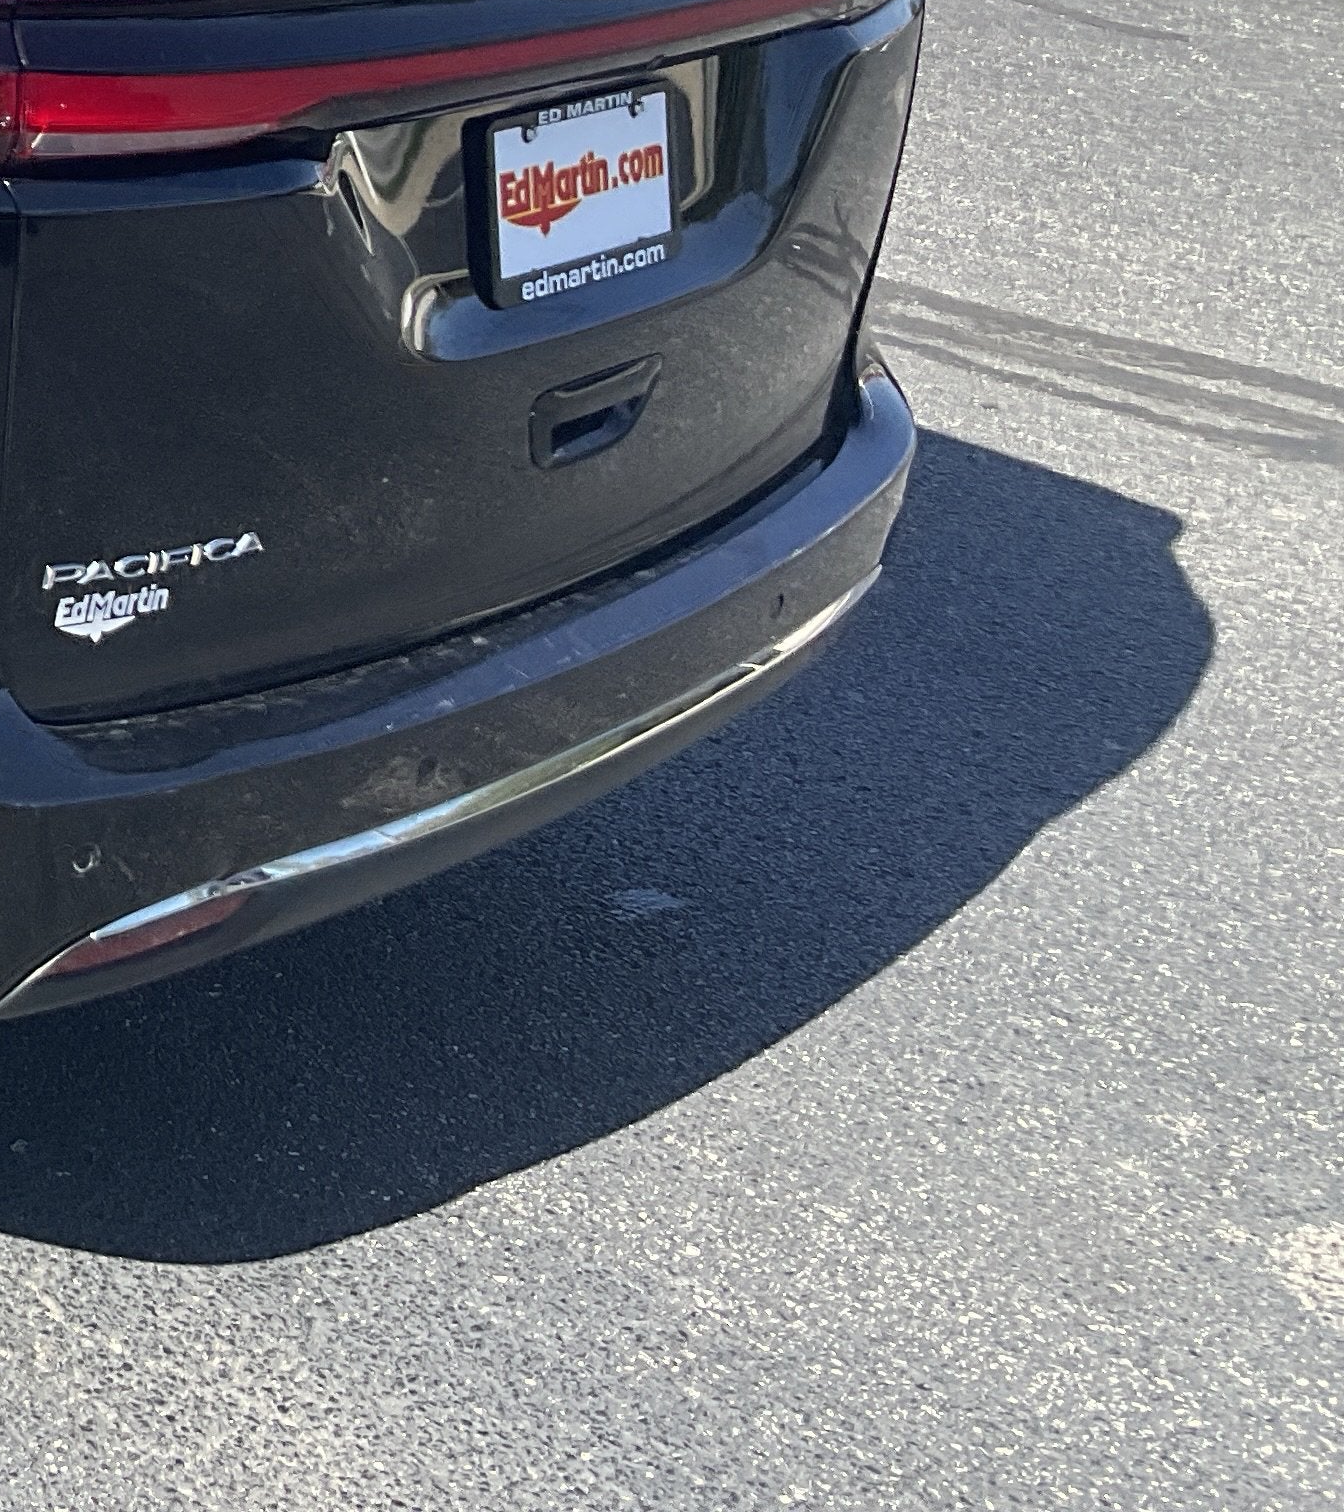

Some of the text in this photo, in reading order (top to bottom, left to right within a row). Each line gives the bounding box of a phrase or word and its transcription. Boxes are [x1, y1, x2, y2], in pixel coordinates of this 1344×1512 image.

[537, 90, 634, 126] ED MARTIN
[499, 143, 664, 219] EdMartin.com
[521, 243, 666, 301] edmartin.com
[41, 531, 265, 590] PACIFICA
[54, 583, 170, 628] EdMartin
